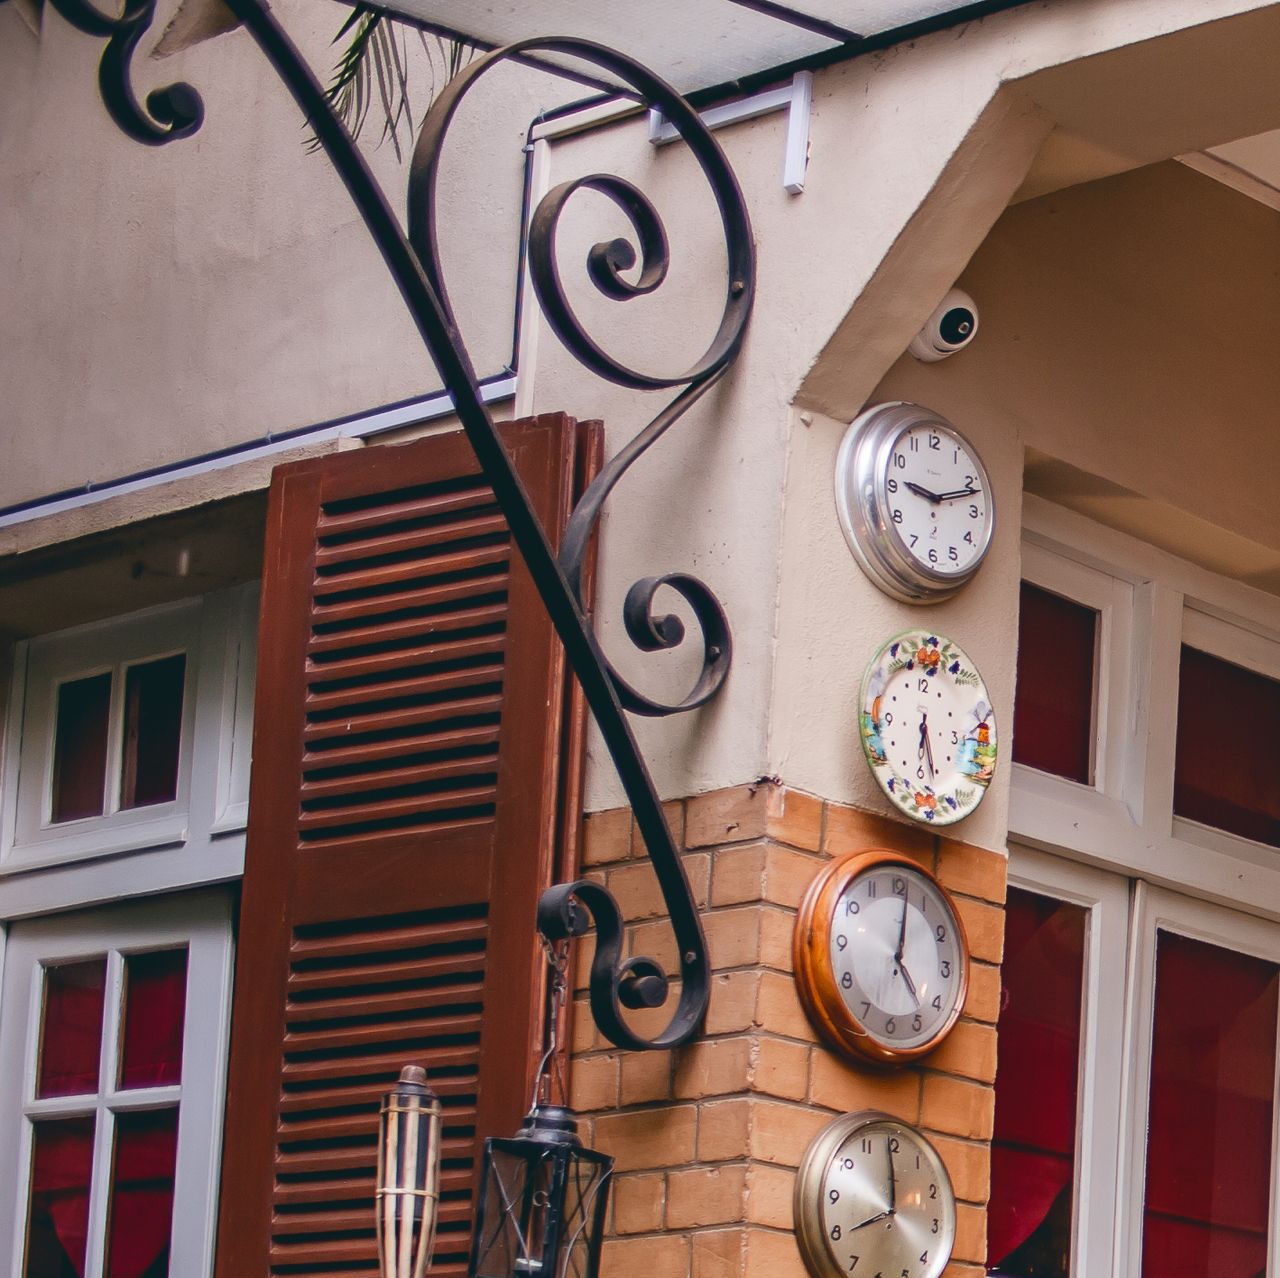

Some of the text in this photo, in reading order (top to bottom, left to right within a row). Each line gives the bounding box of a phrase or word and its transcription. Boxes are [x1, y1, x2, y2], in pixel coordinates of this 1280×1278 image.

[910, 436, 919, 453] 11
[928, 433, 941, 451] 12
[894, 452, 906, 470] 10
[887, 478, 898, 494] 9
[964, 475, 974, 490] 2
[892, 509, 904, 524] 8
[968, 504, 979, 519] 3
[909, 533, 919, 548] 7
[963, 530, 973, 546] 4
[928, 548, 938, 563] 6
[948, 546, 958, 561] 5
[918, 678, 929, 694] 12
[884, 712, 894, 727] 9
[951, 730, 959, 745] 3
[916, 764, 925, 780] 6
[868, 880, 877, 898] 11
[892, 878, 906, 897] 12
[845, 899, 860, 917] 10
[936, 924, 946, 943] 2
[836, 934, 848, 952] 9
[940, 960, 951, 979] 3
[841, 971, 853, 990] 8
[860, 1001, 871, 1020] 7
[931, 994, 942, 1012] 4
[885, 1017, 896, 1035] 6
[911, 1014, 922, 1032] 5
[861, 1138, 872, 1155] 11
[887, 1137, 900, 1154] 2
[828, 1189, 840, 1205] 9
[929, 1183, 937, 1200] 2
[830, 1224, 842, 1242] 8
[931, 1218, 939, 1234] 3
[849, 1255, 860, 1272] 7
[919, 1250, 928, 1266] 4
